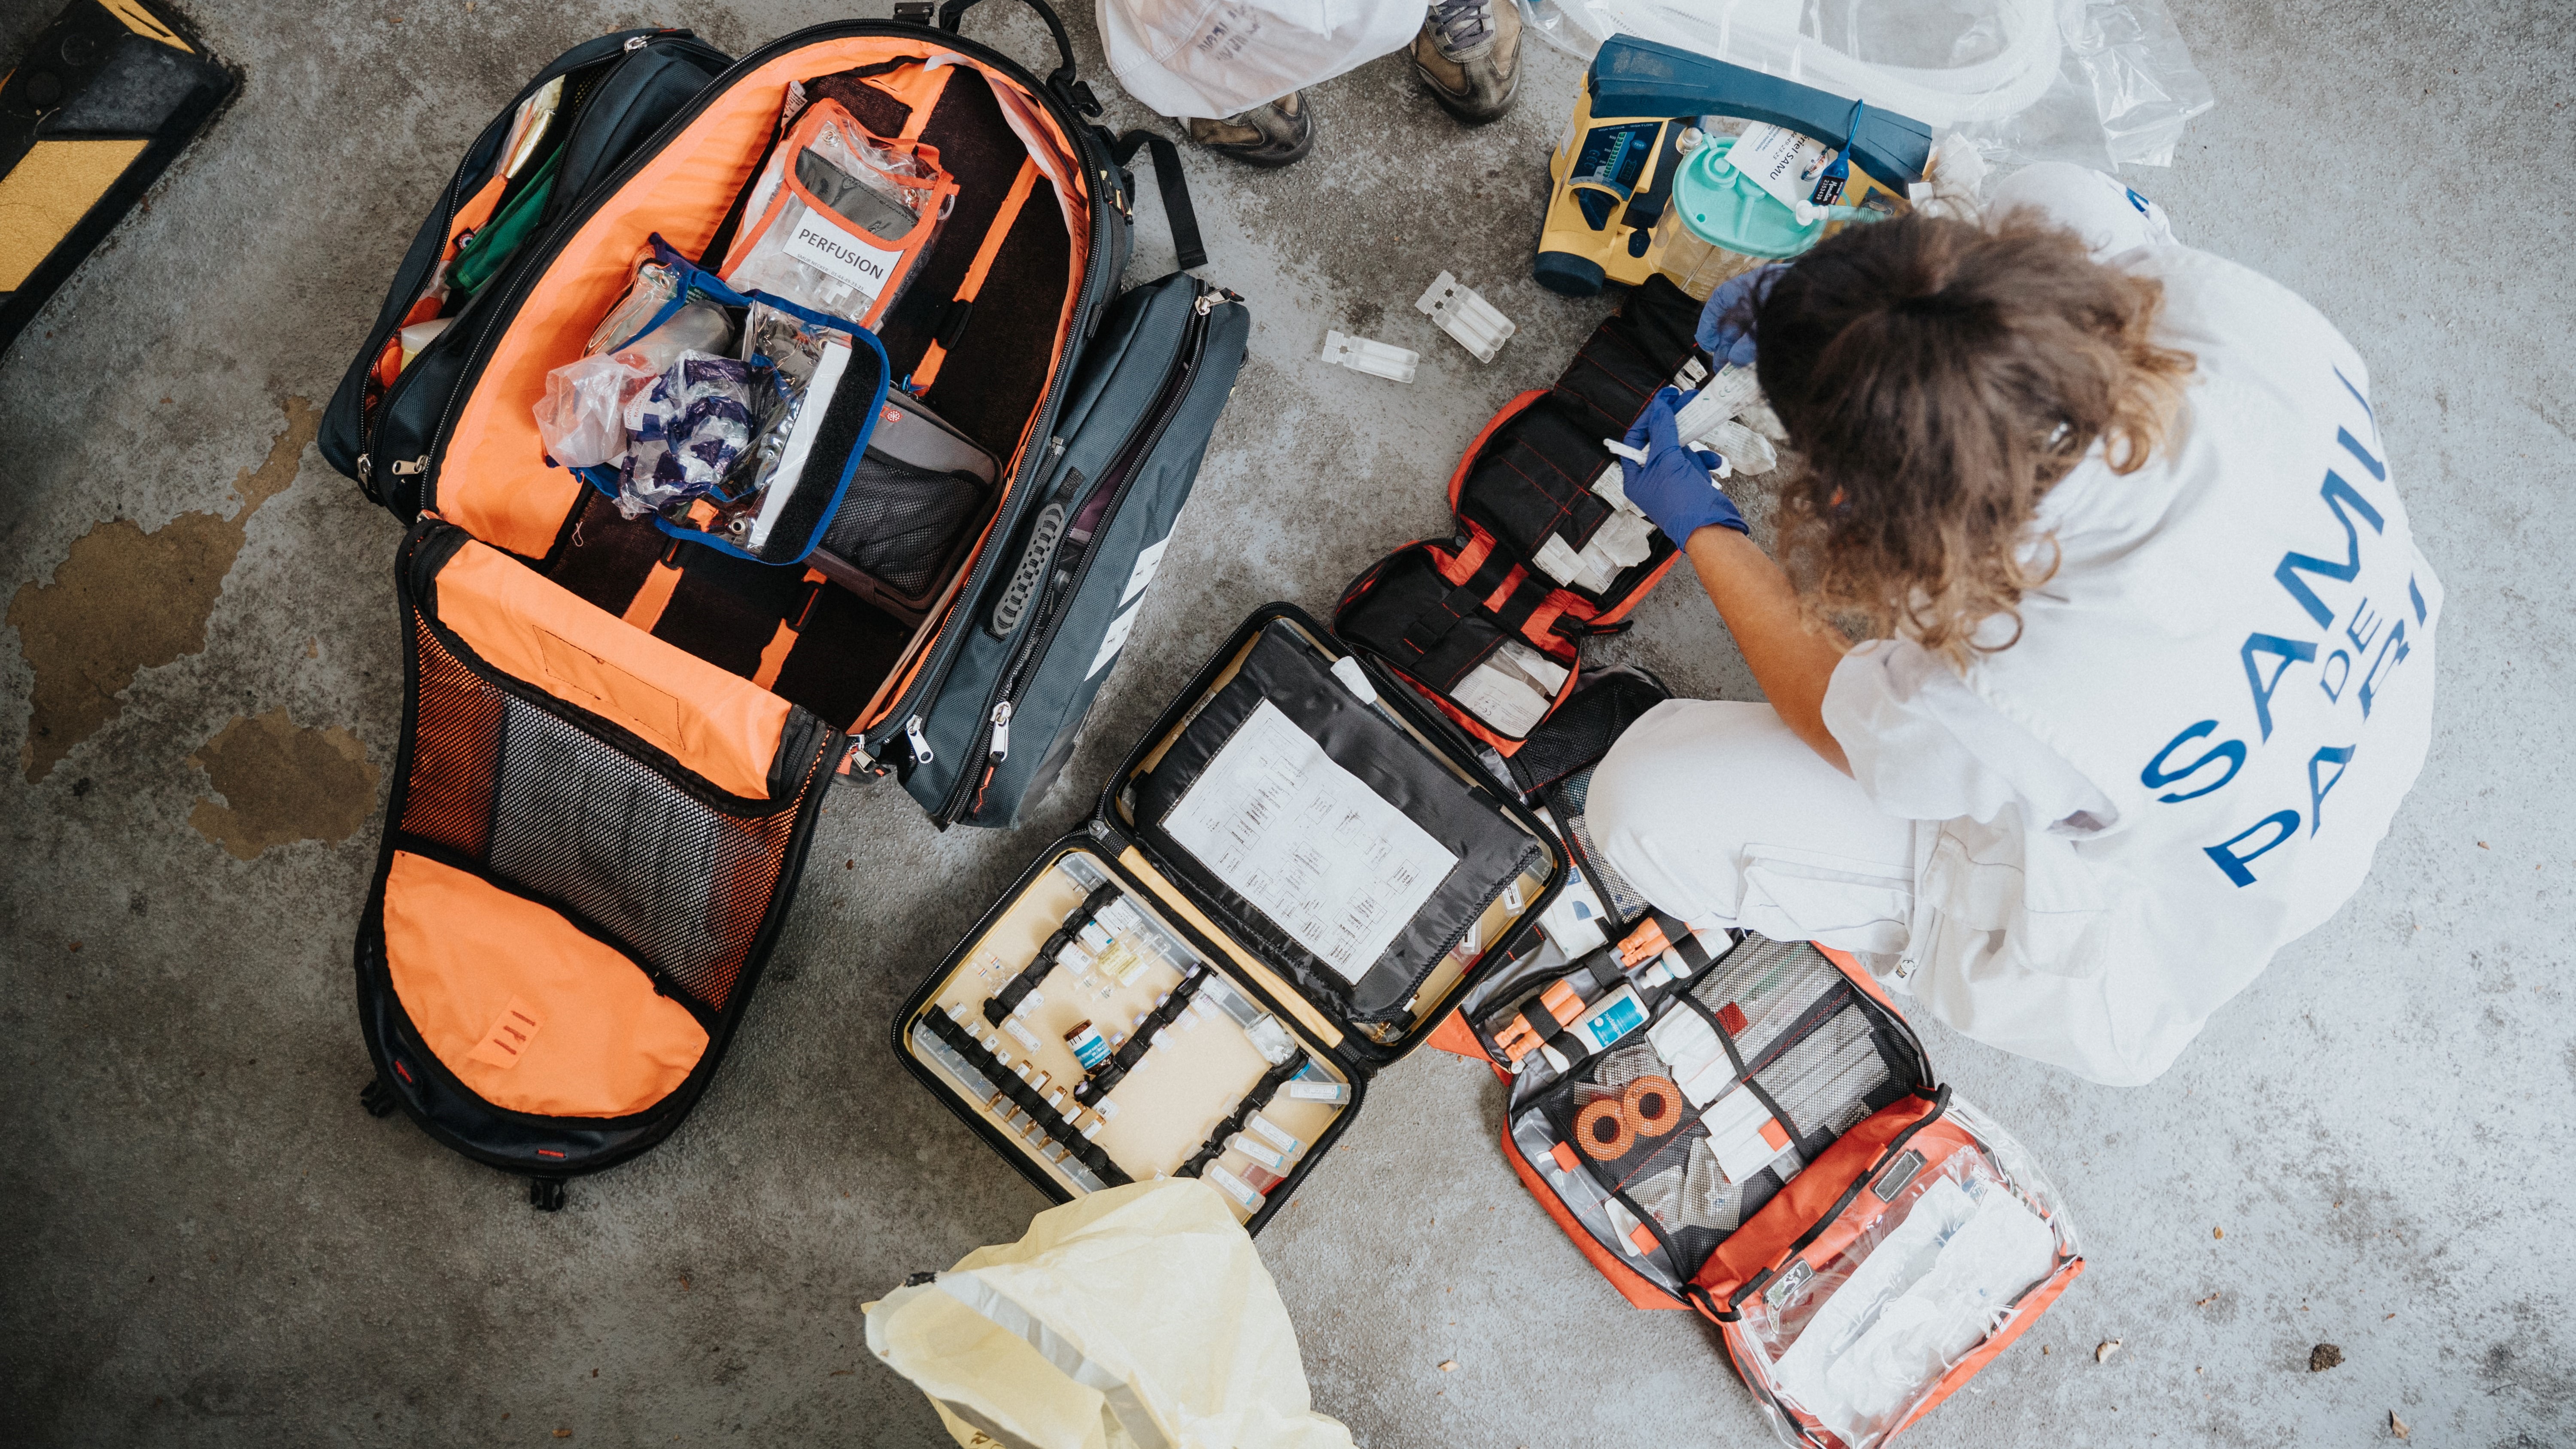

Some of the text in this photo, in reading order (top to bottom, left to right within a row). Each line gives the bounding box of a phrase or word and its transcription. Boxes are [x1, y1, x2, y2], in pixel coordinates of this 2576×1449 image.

[1754, 125, 1777, 152] ants malades
[1760, 125, 1783, 152] pital Necker
[1772, 130, 1798, 160] 44-49-23-23
[1768, 133, 1810, 181] ériel SAMU
[1816, 179, 1829, 201] 2353439
[1822, 180, 1837, 203] Manutan
[798, 227, 884, 280] PERFUSION
[796, 253, 811, 264] SMUR
[810, 260, 829, 273] NECKER
[830, 270, 864, 291] 01-44-49-23-23
[634, 400, 642, 417] MASK
[1594, 582, 1605, 592] 20ml
[2140, 365, 2386, 804] SAMU
[2320, 597, 2382, 703] DE
[1187, 706, 1202, 723] STUP
[1201, 696, 1211, 706] 140
[2202, 572, 2428, 889] PARI
[1218, 851, 1230, 864] Atropine
[1571, 869, 1579, 882] LCH
